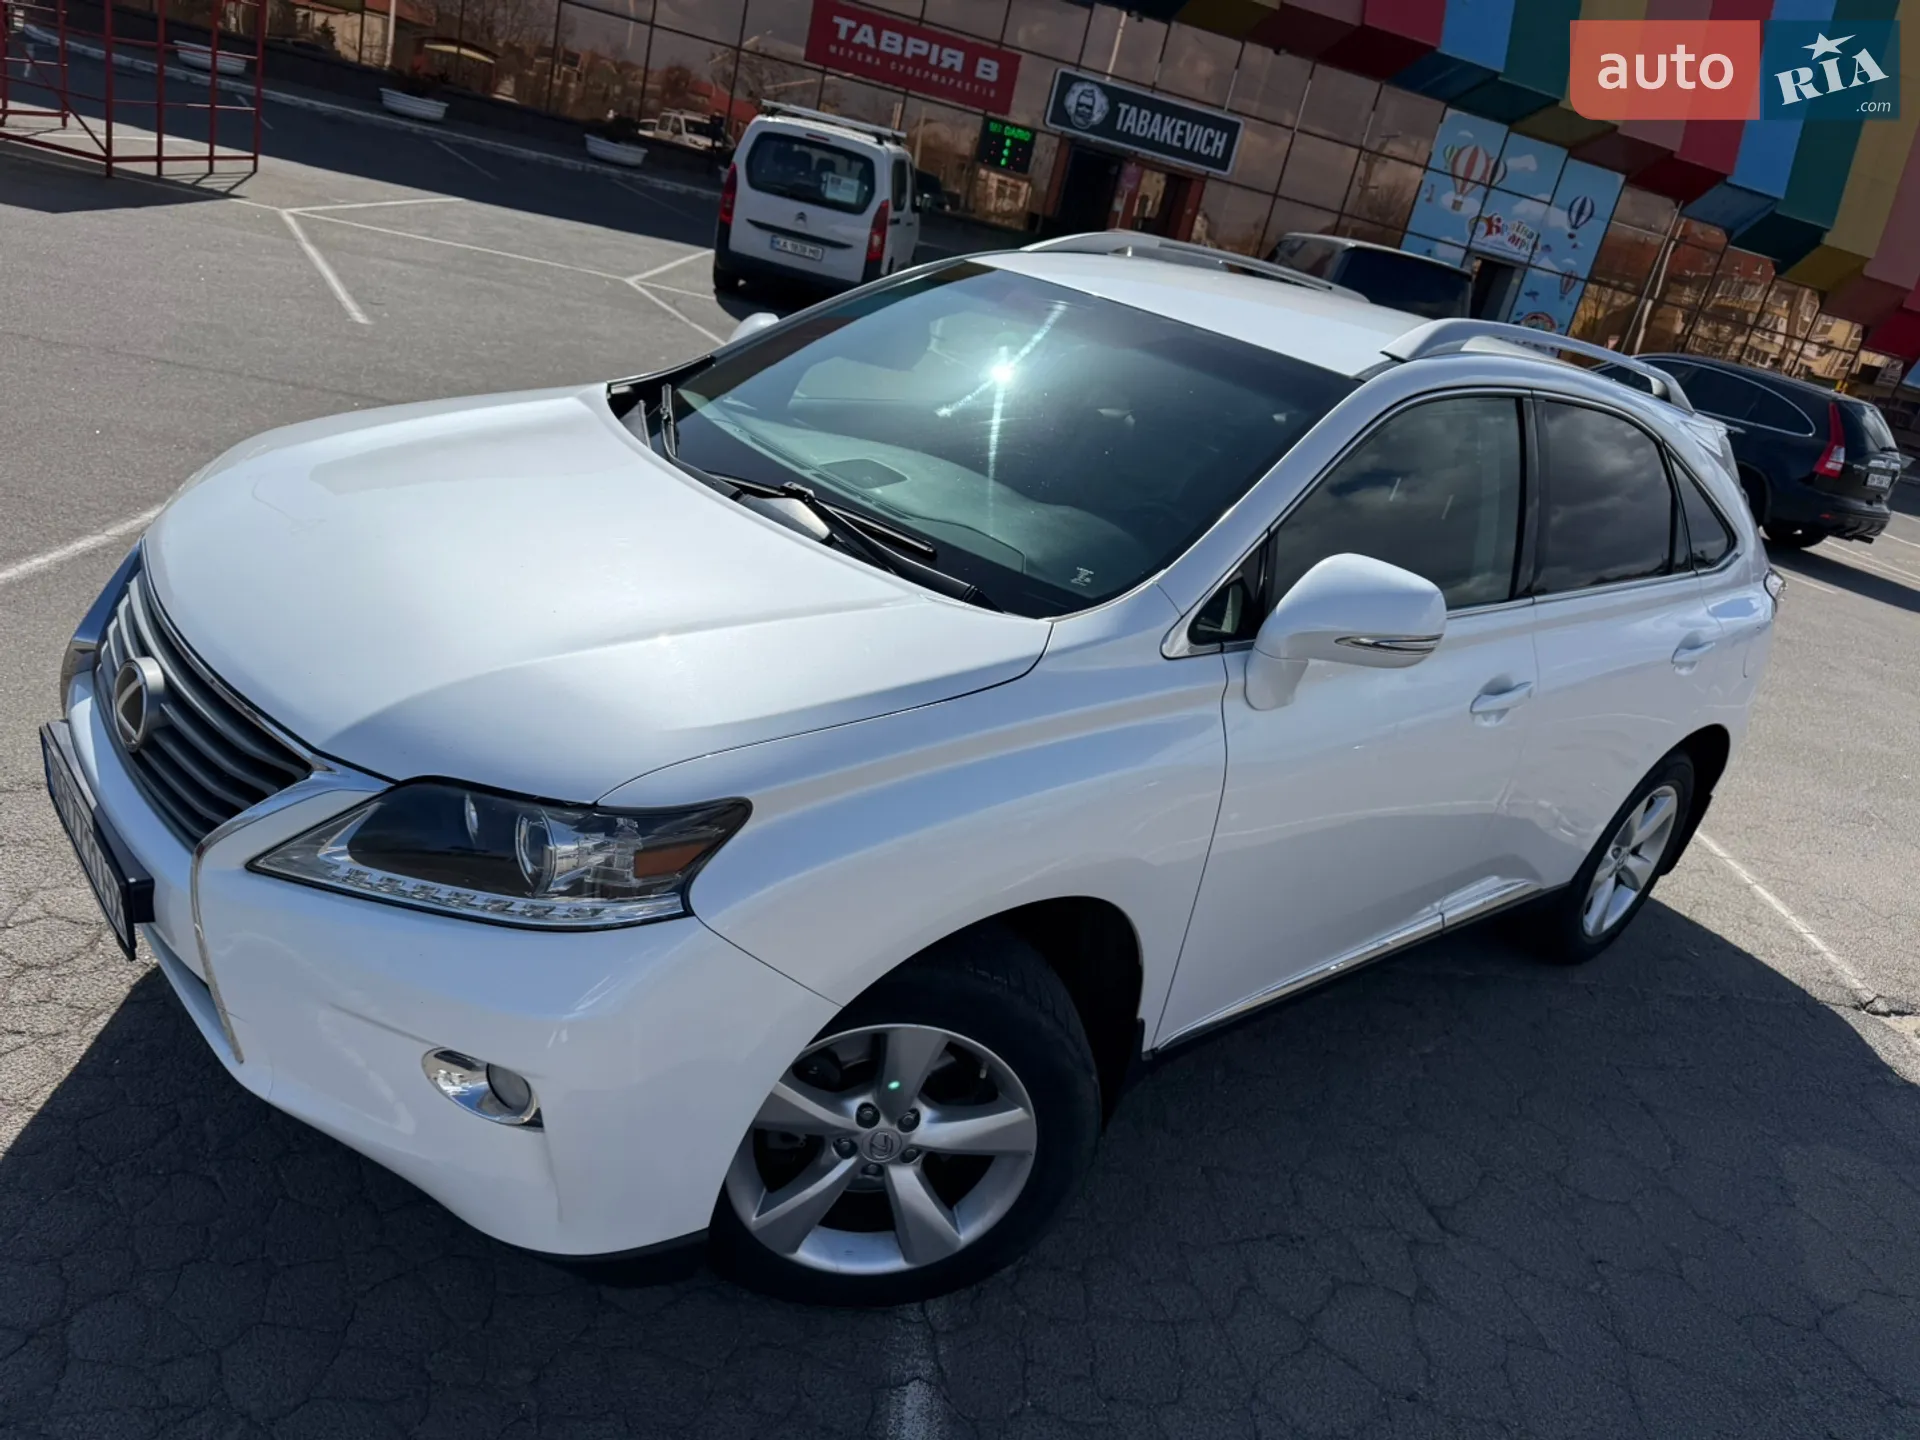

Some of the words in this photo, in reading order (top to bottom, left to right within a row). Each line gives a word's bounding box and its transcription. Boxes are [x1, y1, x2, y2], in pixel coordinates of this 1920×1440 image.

[832, 15, 965, 73] ТАВРІЯ
[975, 57, 1000, 83] В
[1115, 102, 1229, 159] TABAKEVICH
